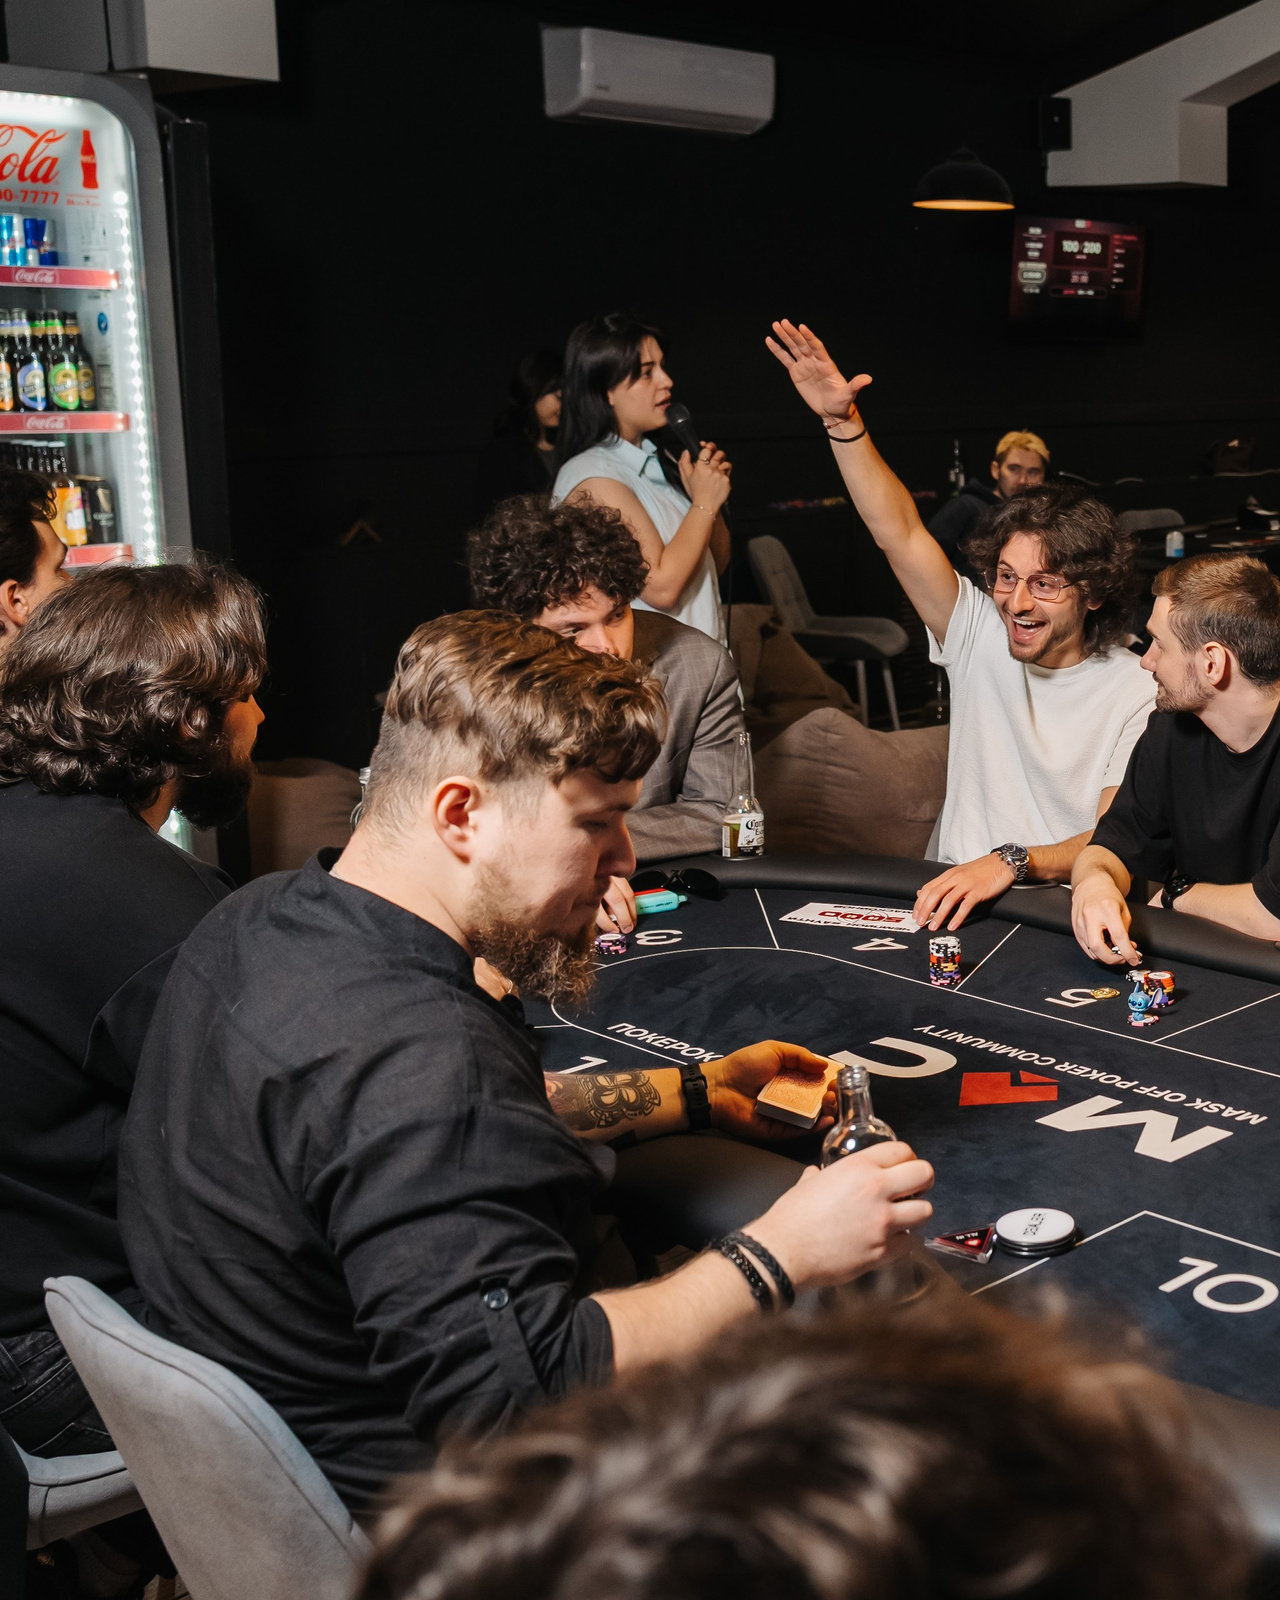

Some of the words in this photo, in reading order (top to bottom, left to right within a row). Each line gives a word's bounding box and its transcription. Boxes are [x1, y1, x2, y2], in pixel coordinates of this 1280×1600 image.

[1083, 241, 1102, 254] 200
[818, 910, 906, 924] 5000
[634, 929, 684, 946] 3
[851, 937, 909, 951] 4
[1044, 988, 1099, 1008] 5
[607, 1022, 724, 1064] ПОКЕРОК
[913, 1024, 1057, 1066] COMMUNITY
[1053, 1061, 1140, 1090] POKER
[1132, 1084, 1187, 1103] OFF
[1184, 1097, 1268, 1126] MASK
[1158, 1256, 1280, 1314] 10
